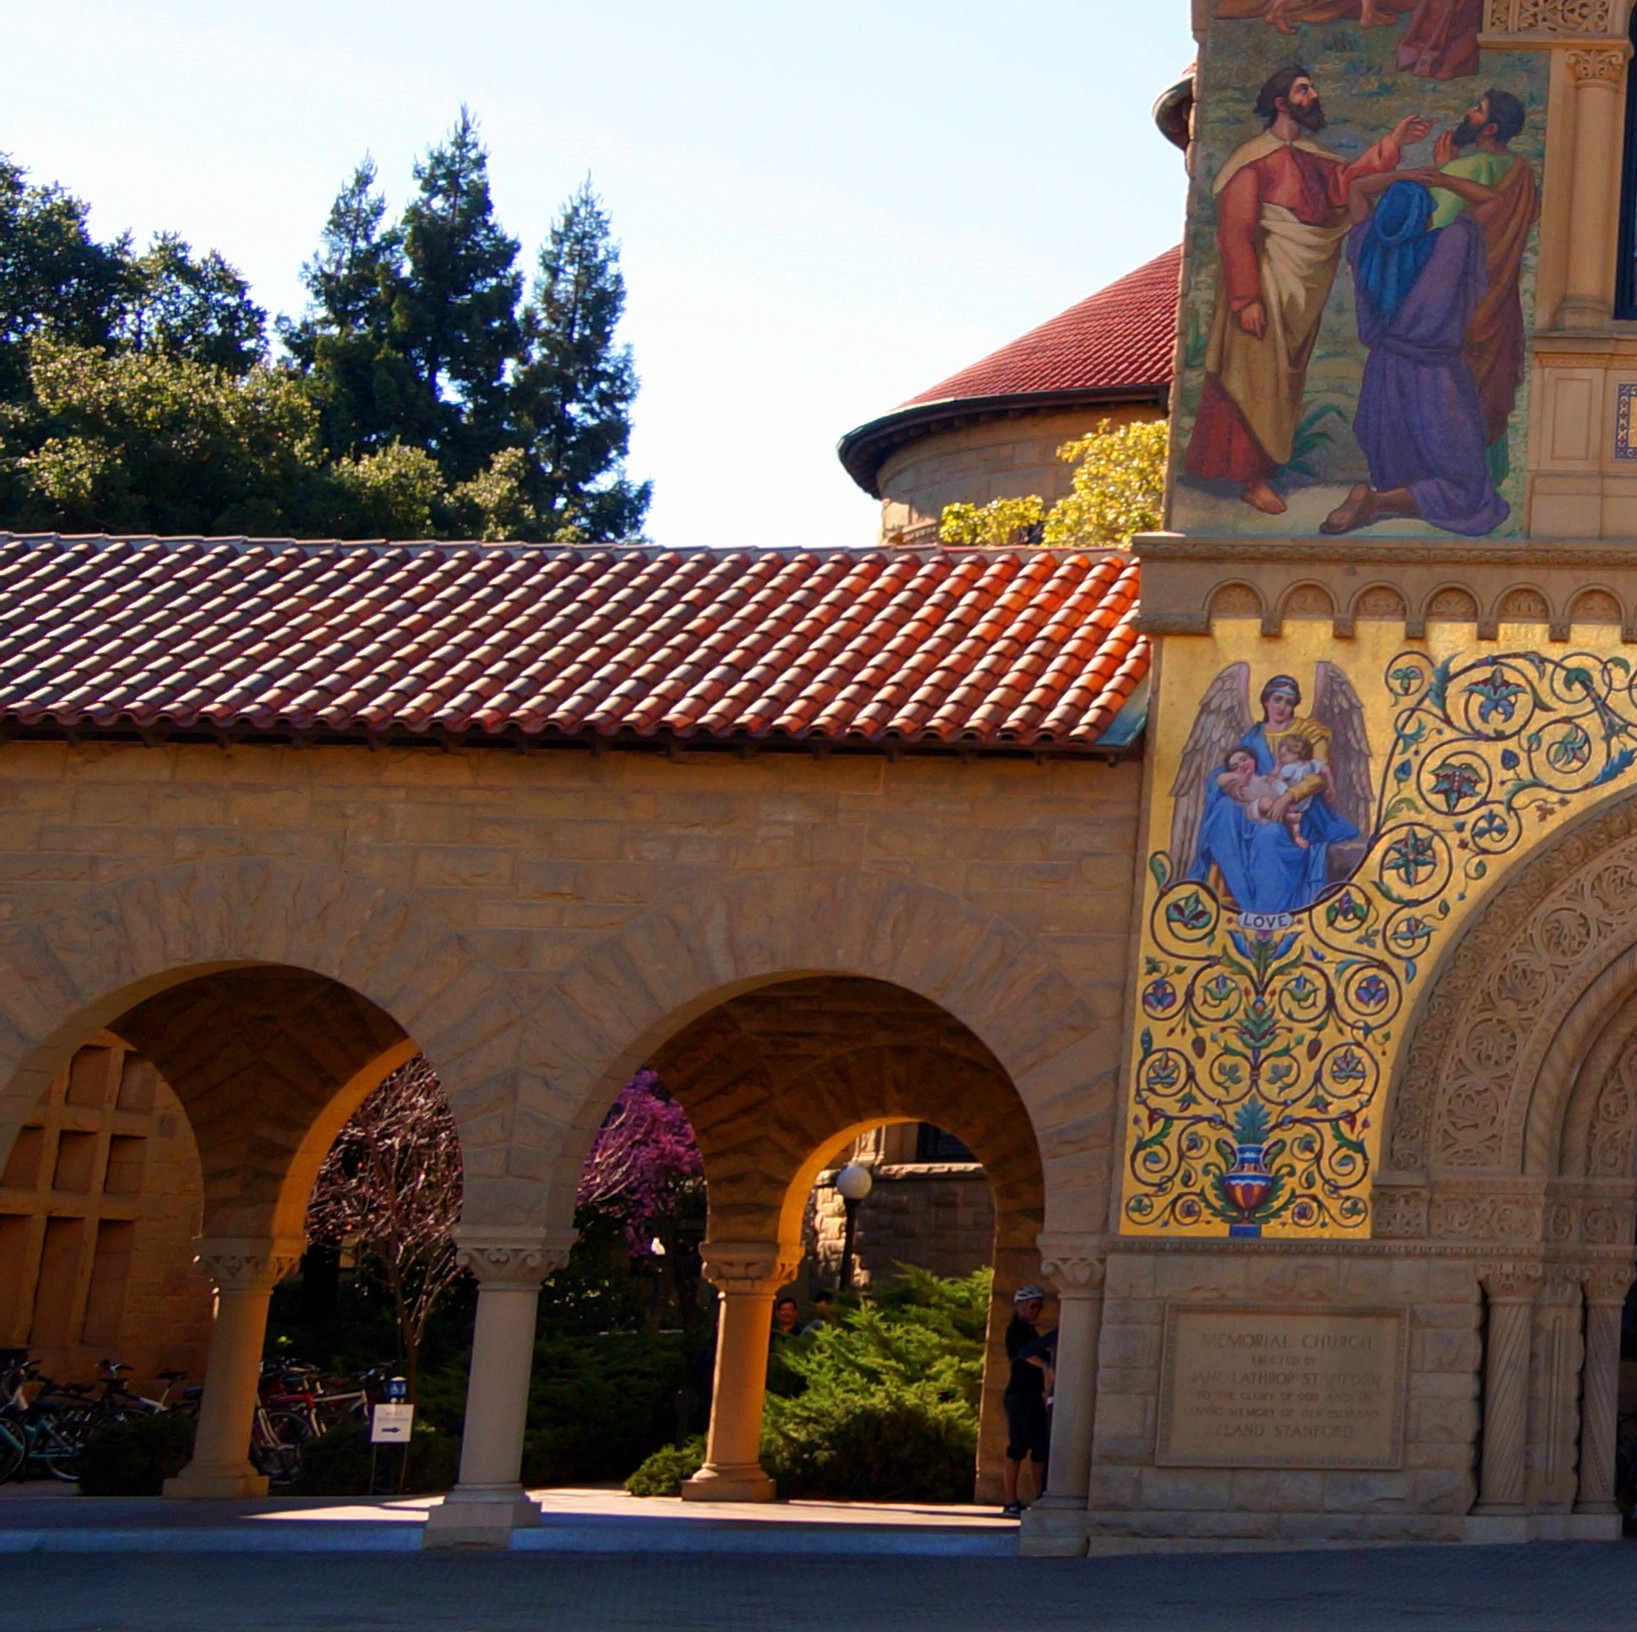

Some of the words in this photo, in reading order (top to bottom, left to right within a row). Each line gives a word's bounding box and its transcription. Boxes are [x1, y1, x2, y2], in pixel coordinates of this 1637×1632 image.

[1243, 912, 1289, 929] LOVE
[1201, 1332, 1290, 1349] MEMORIAL
[1301, 1334, 1372, 1351] CHURCH
[1232, 1371, 1296, 1385] LATHROP
[1296, 1392, 1320, 1402] GOD
[1273, 1424, 1354, 1439] STANFORD
